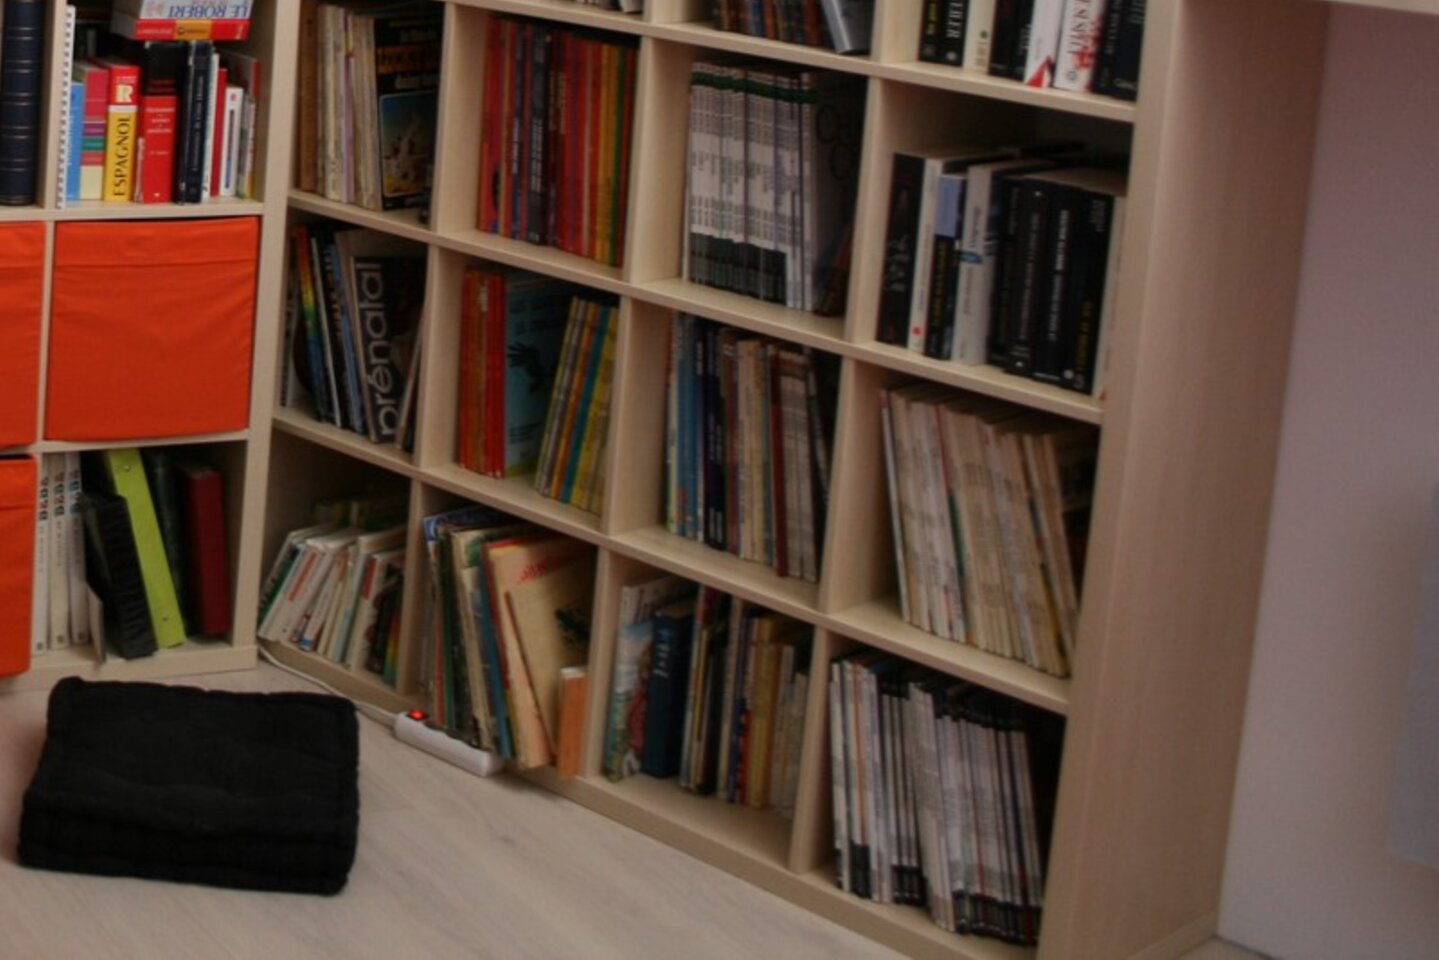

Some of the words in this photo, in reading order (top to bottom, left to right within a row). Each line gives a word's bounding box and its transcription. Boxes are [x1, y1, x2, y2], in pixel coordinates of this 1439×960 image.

[167, 5, 228, 19] ROBERT
[231, 5, 249, 18] LE
[115, 84, 133, 102] R
[113, 115, 131, 196] ESPAGNOL
[358, 263, 400, 437] prénatal
